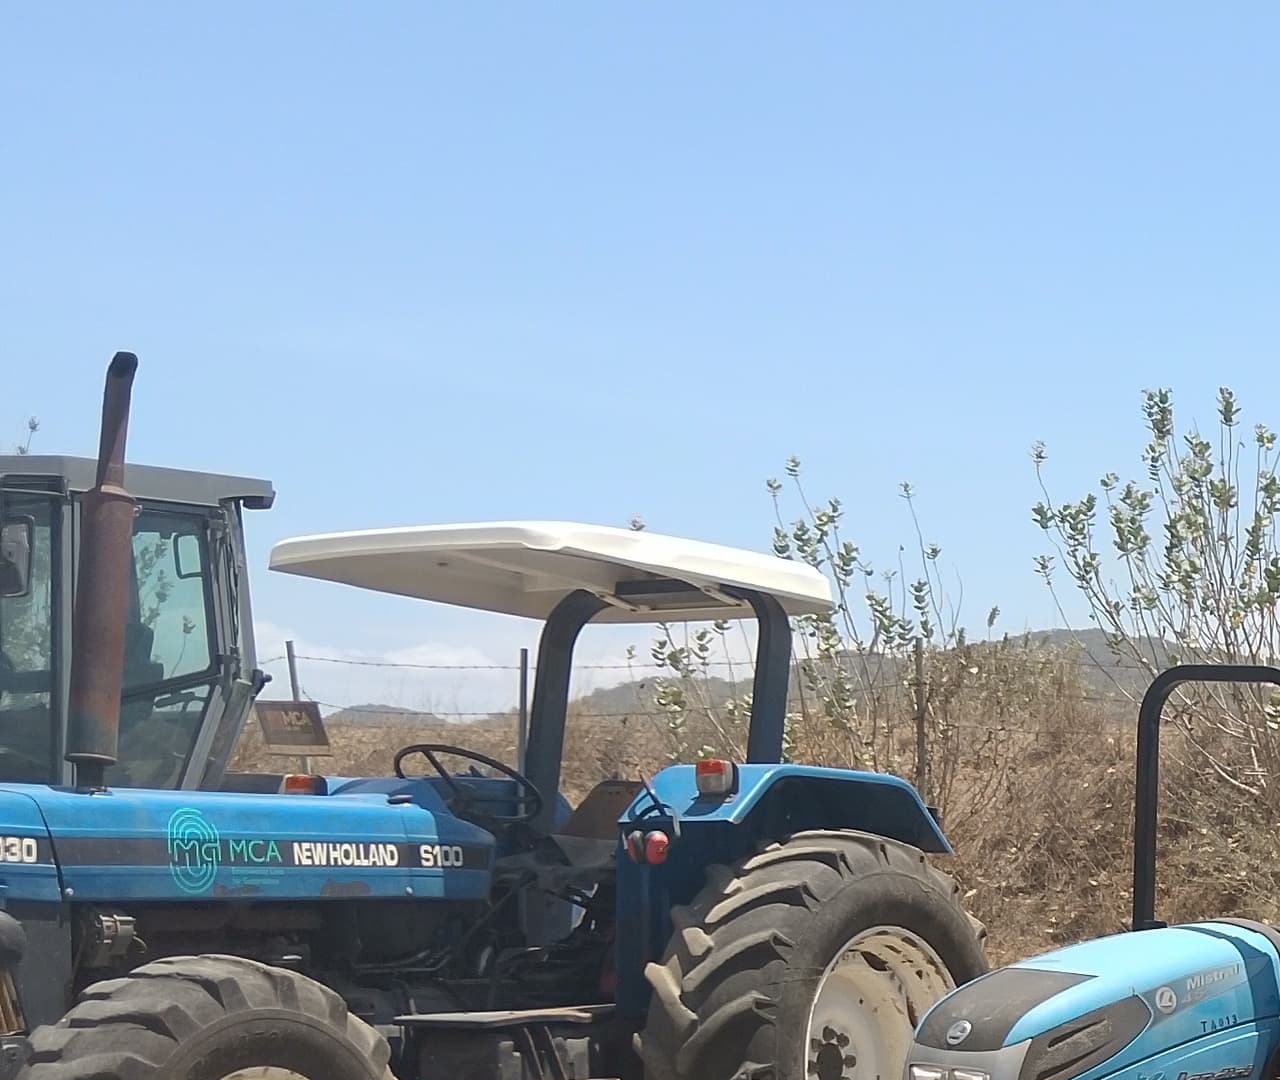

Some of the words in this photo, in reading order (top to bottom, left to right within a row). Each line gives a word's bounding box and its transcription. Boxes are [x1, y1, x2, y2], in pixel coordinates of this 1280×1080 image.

[229, 839, 282, 863] MCA
[293, 842, 327, 866] NEW
[329, 842, 399, 867] HOLLAND
[419, 844, 464, 868] S100
